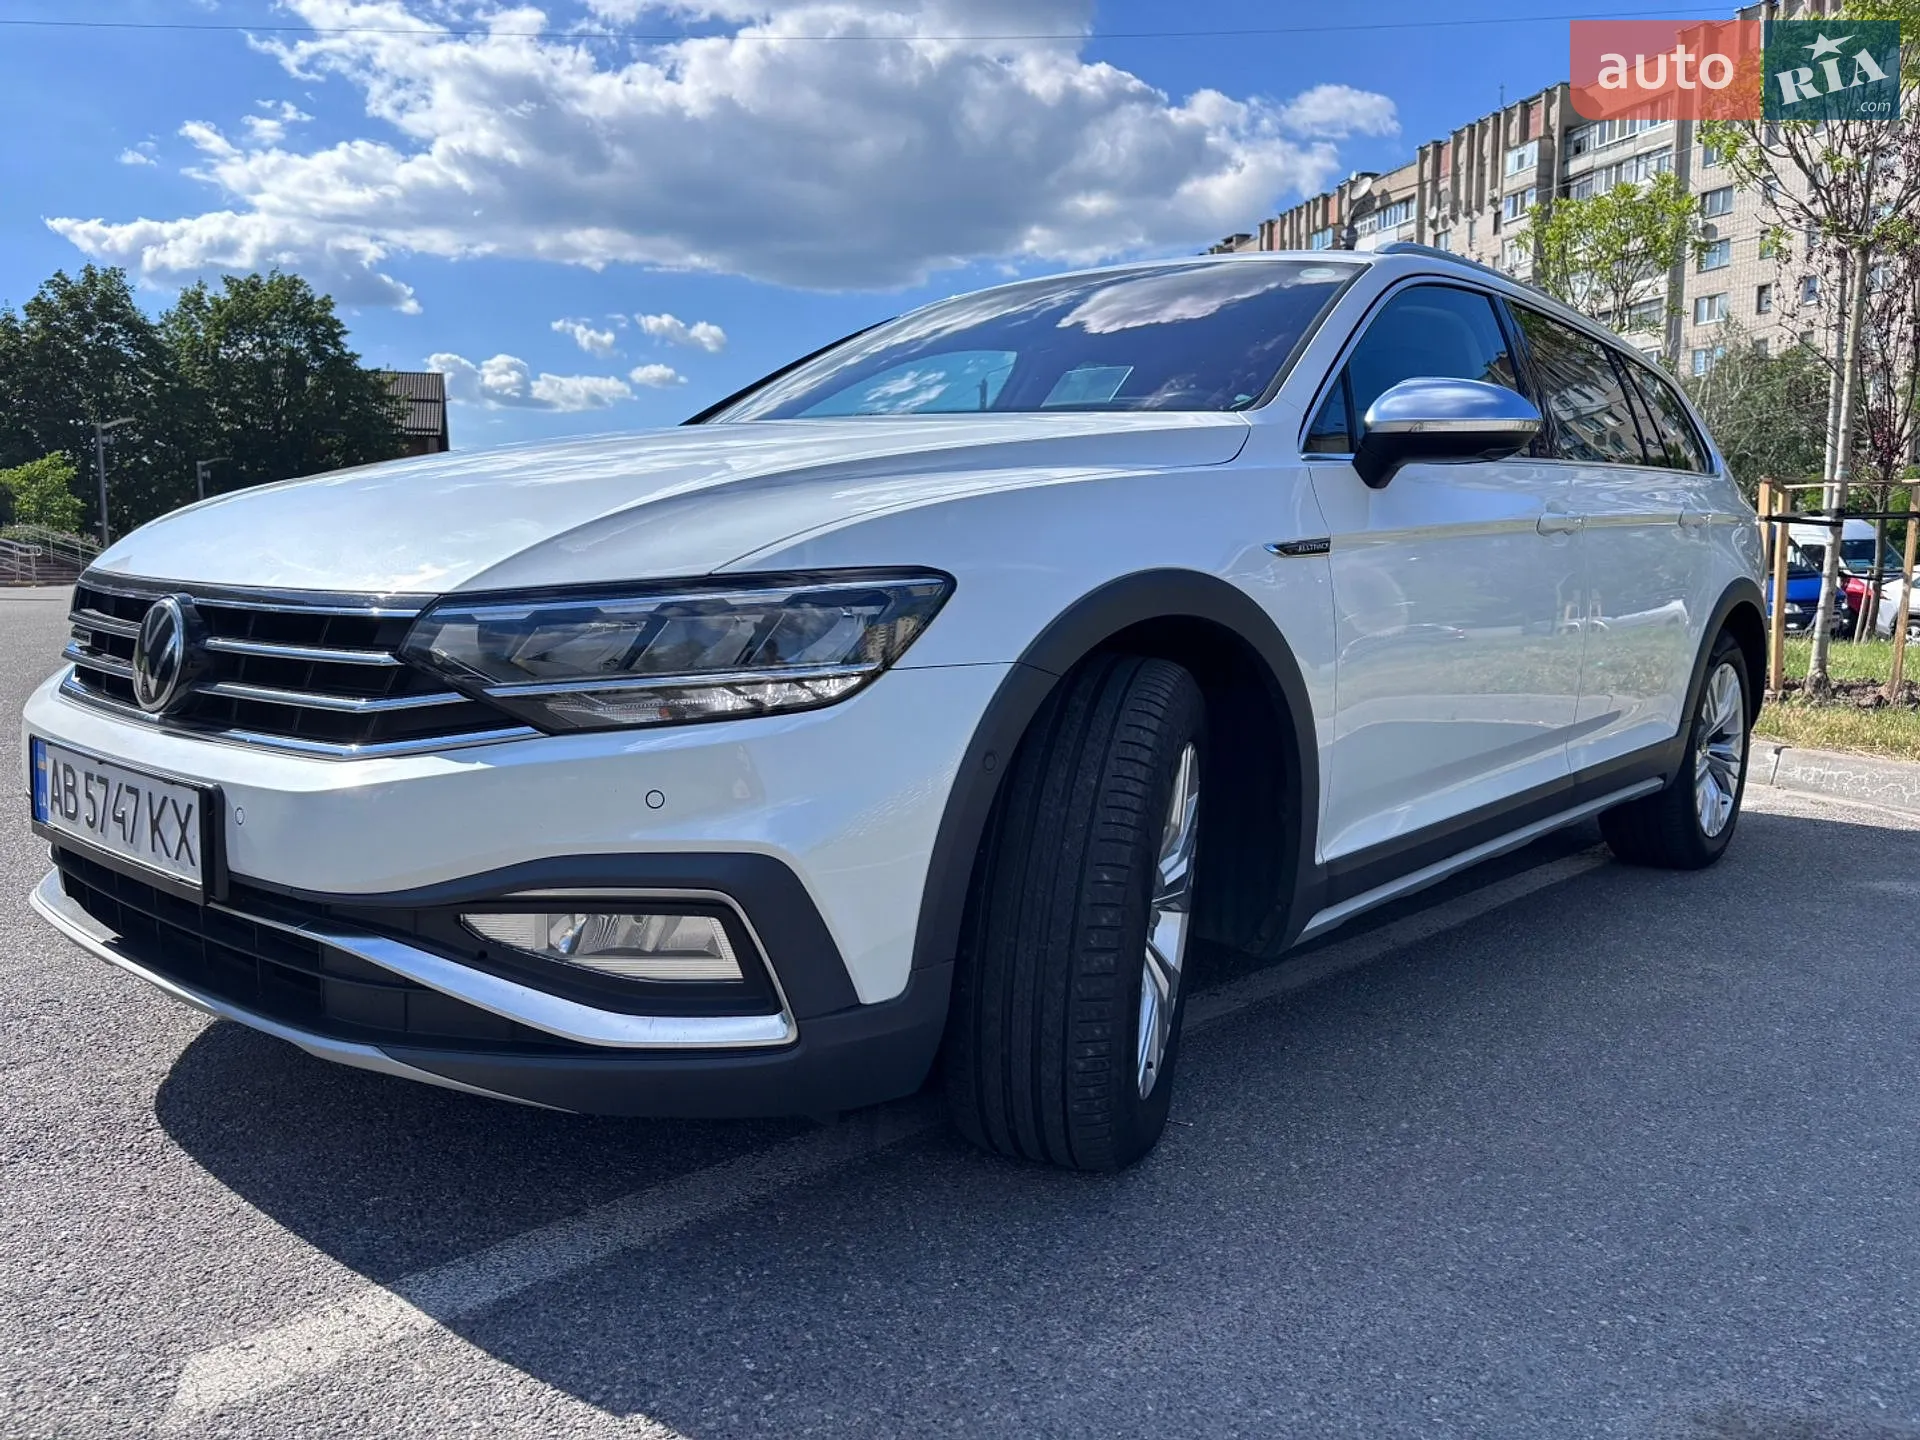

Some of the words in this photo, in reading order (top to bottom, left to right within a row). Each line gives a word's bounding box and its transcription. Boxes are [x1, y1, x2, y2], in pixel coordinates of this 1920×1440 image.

[51, 758, 78, 821] AB
[84, 771, 140, 844] 5747
[148, 791, 196, 867] KX
